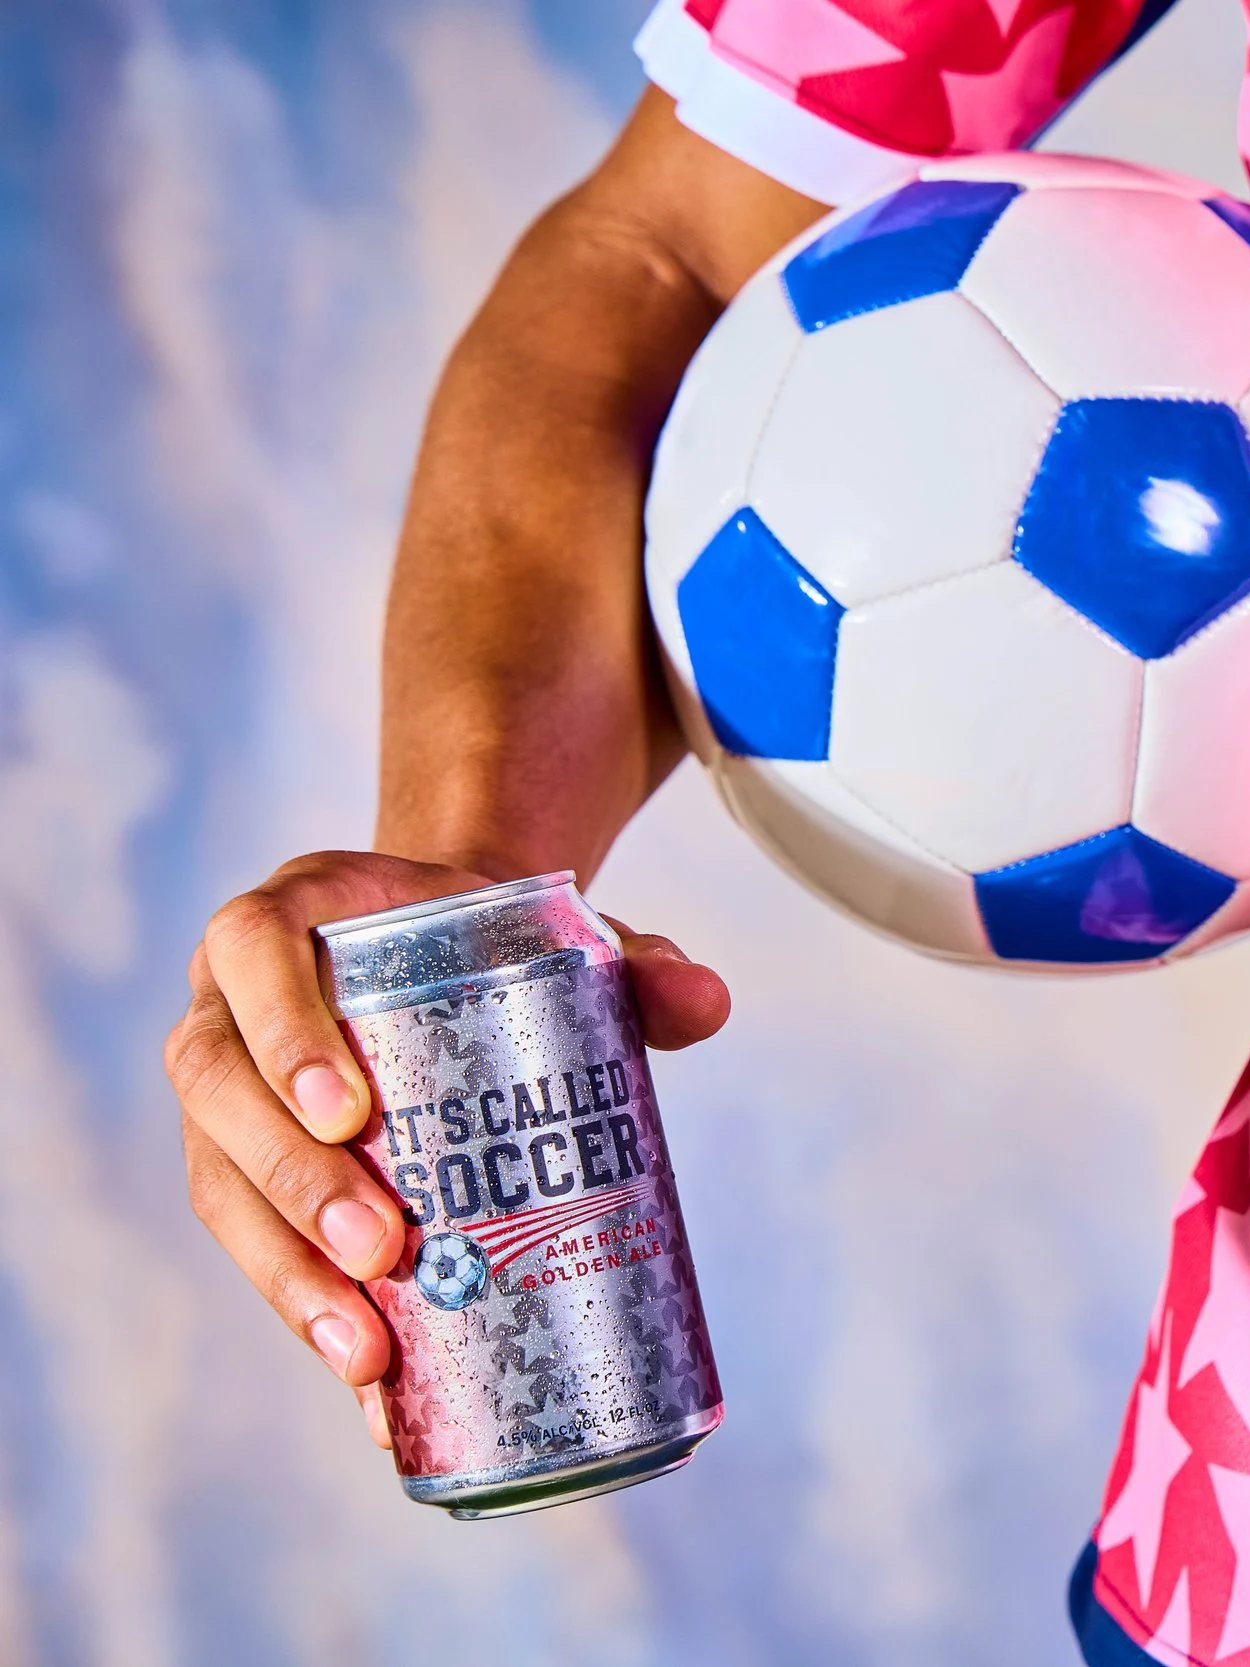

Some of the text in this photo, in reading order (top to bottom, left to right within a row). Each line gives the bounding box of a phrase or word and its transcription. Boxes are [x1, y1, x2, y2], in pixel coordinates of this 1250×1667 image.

[382, 1059, 631, 1157] IT'S CALLED
[394, 1113, 646, 1227] SOCCER
[545, 1217, 657, 1261] AMERICAN
[522, 1240, 662, 1292] GOLDEN ALE
[496, 1430, 538, 1449] 4.5%
[609, 1407, 626, 1424] 12
